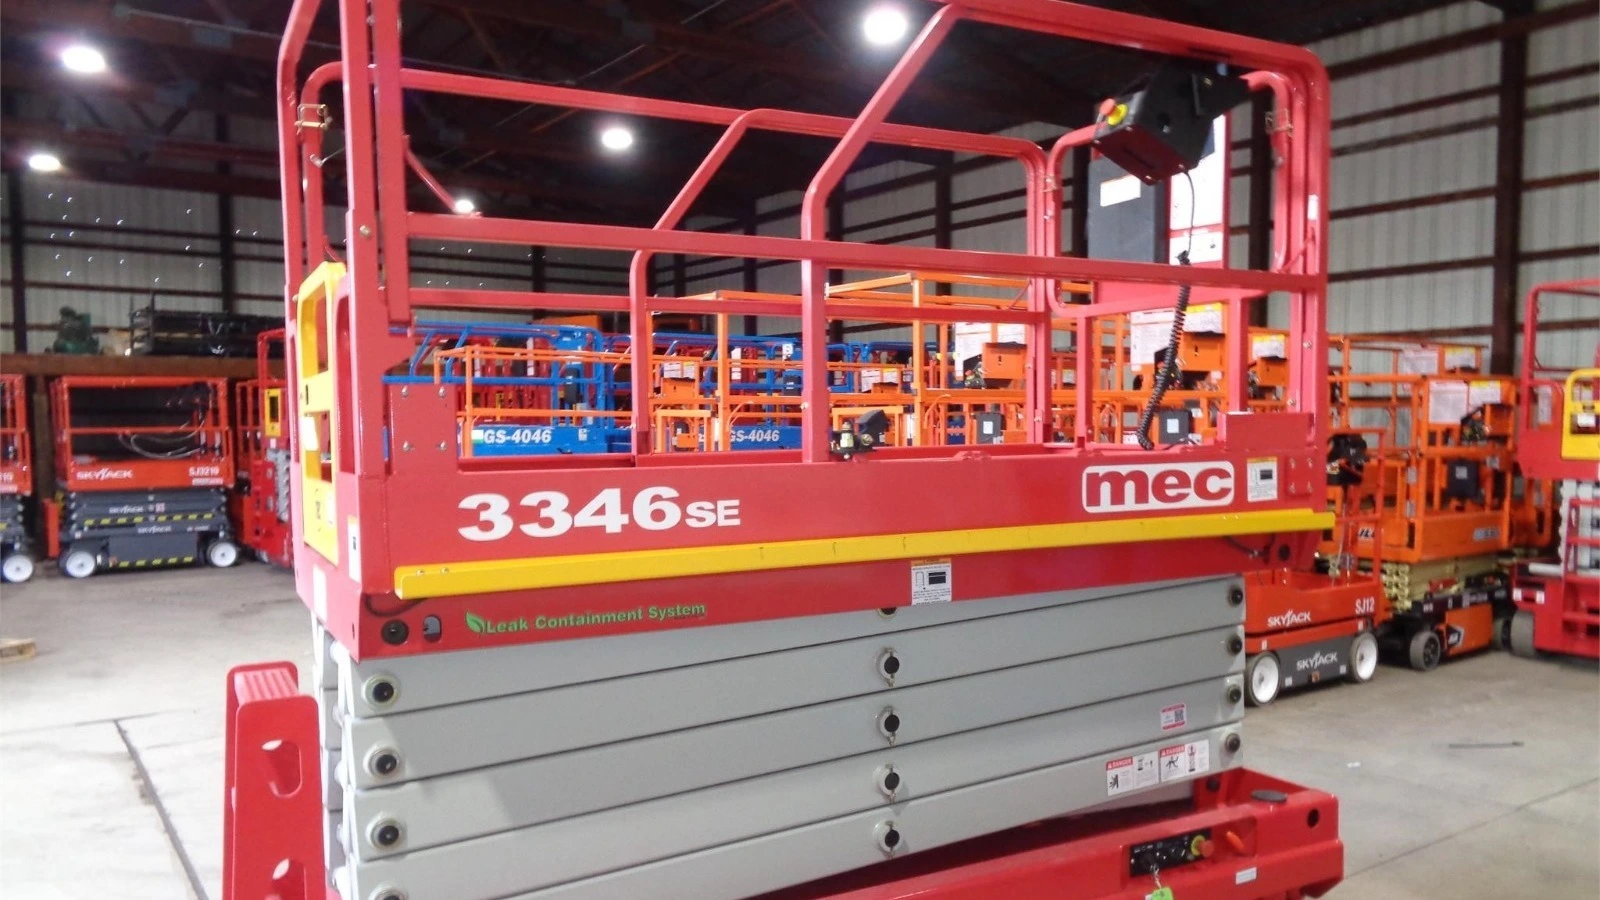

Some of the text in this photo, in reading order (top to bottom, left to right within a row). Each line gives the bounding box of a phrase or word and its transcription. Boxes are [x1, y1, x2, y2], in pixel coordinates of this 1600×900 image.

[484, 429, 552, 444] GS-4046
[76, 467, 133, 480] SKYJACK
[1355, 597, 1375, 615] SJ12
[486, 603, 706, 634] Leak Containment System
[1268, 609, 1312, 627] SKYJACK
[1296, 652, 1338, 670] SKYJACK
